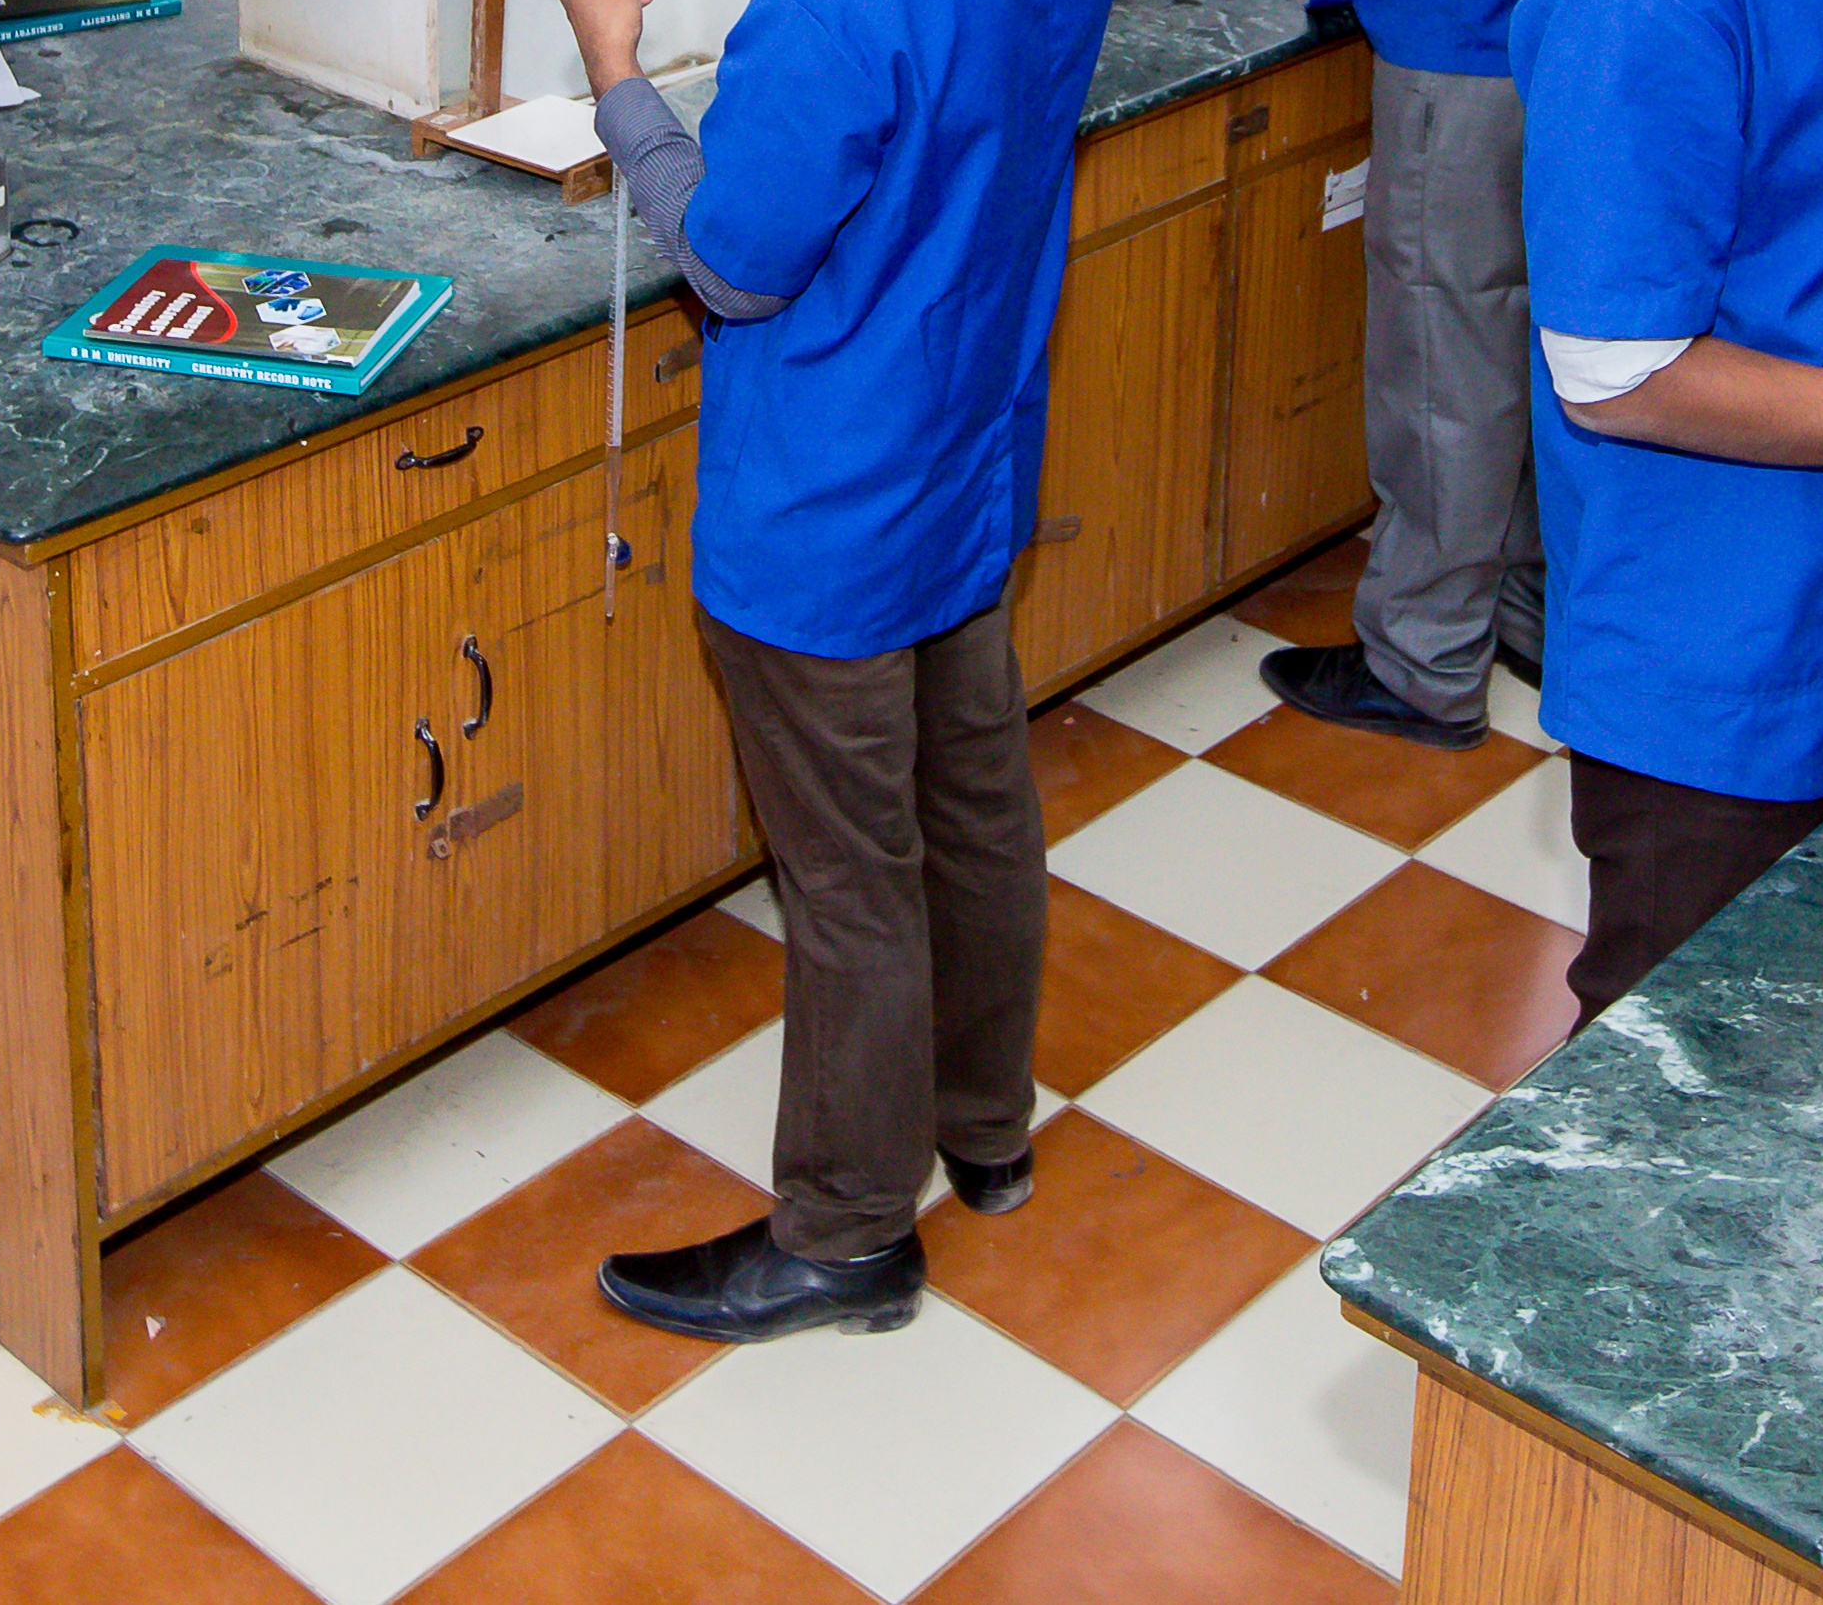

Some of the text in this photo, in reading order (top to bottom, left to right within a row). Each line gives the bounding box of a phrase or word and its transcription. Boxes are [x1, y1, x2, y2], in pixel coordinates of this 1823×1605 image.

[80, 12, 131, 27] UNIVERSITY
[14, 23, 64, 39] CHEMISTRY
[107, 351, 171, 369] UNIVERSITY
[191, 362, 332, 390] CHEMISTRY RECORD NOTE
